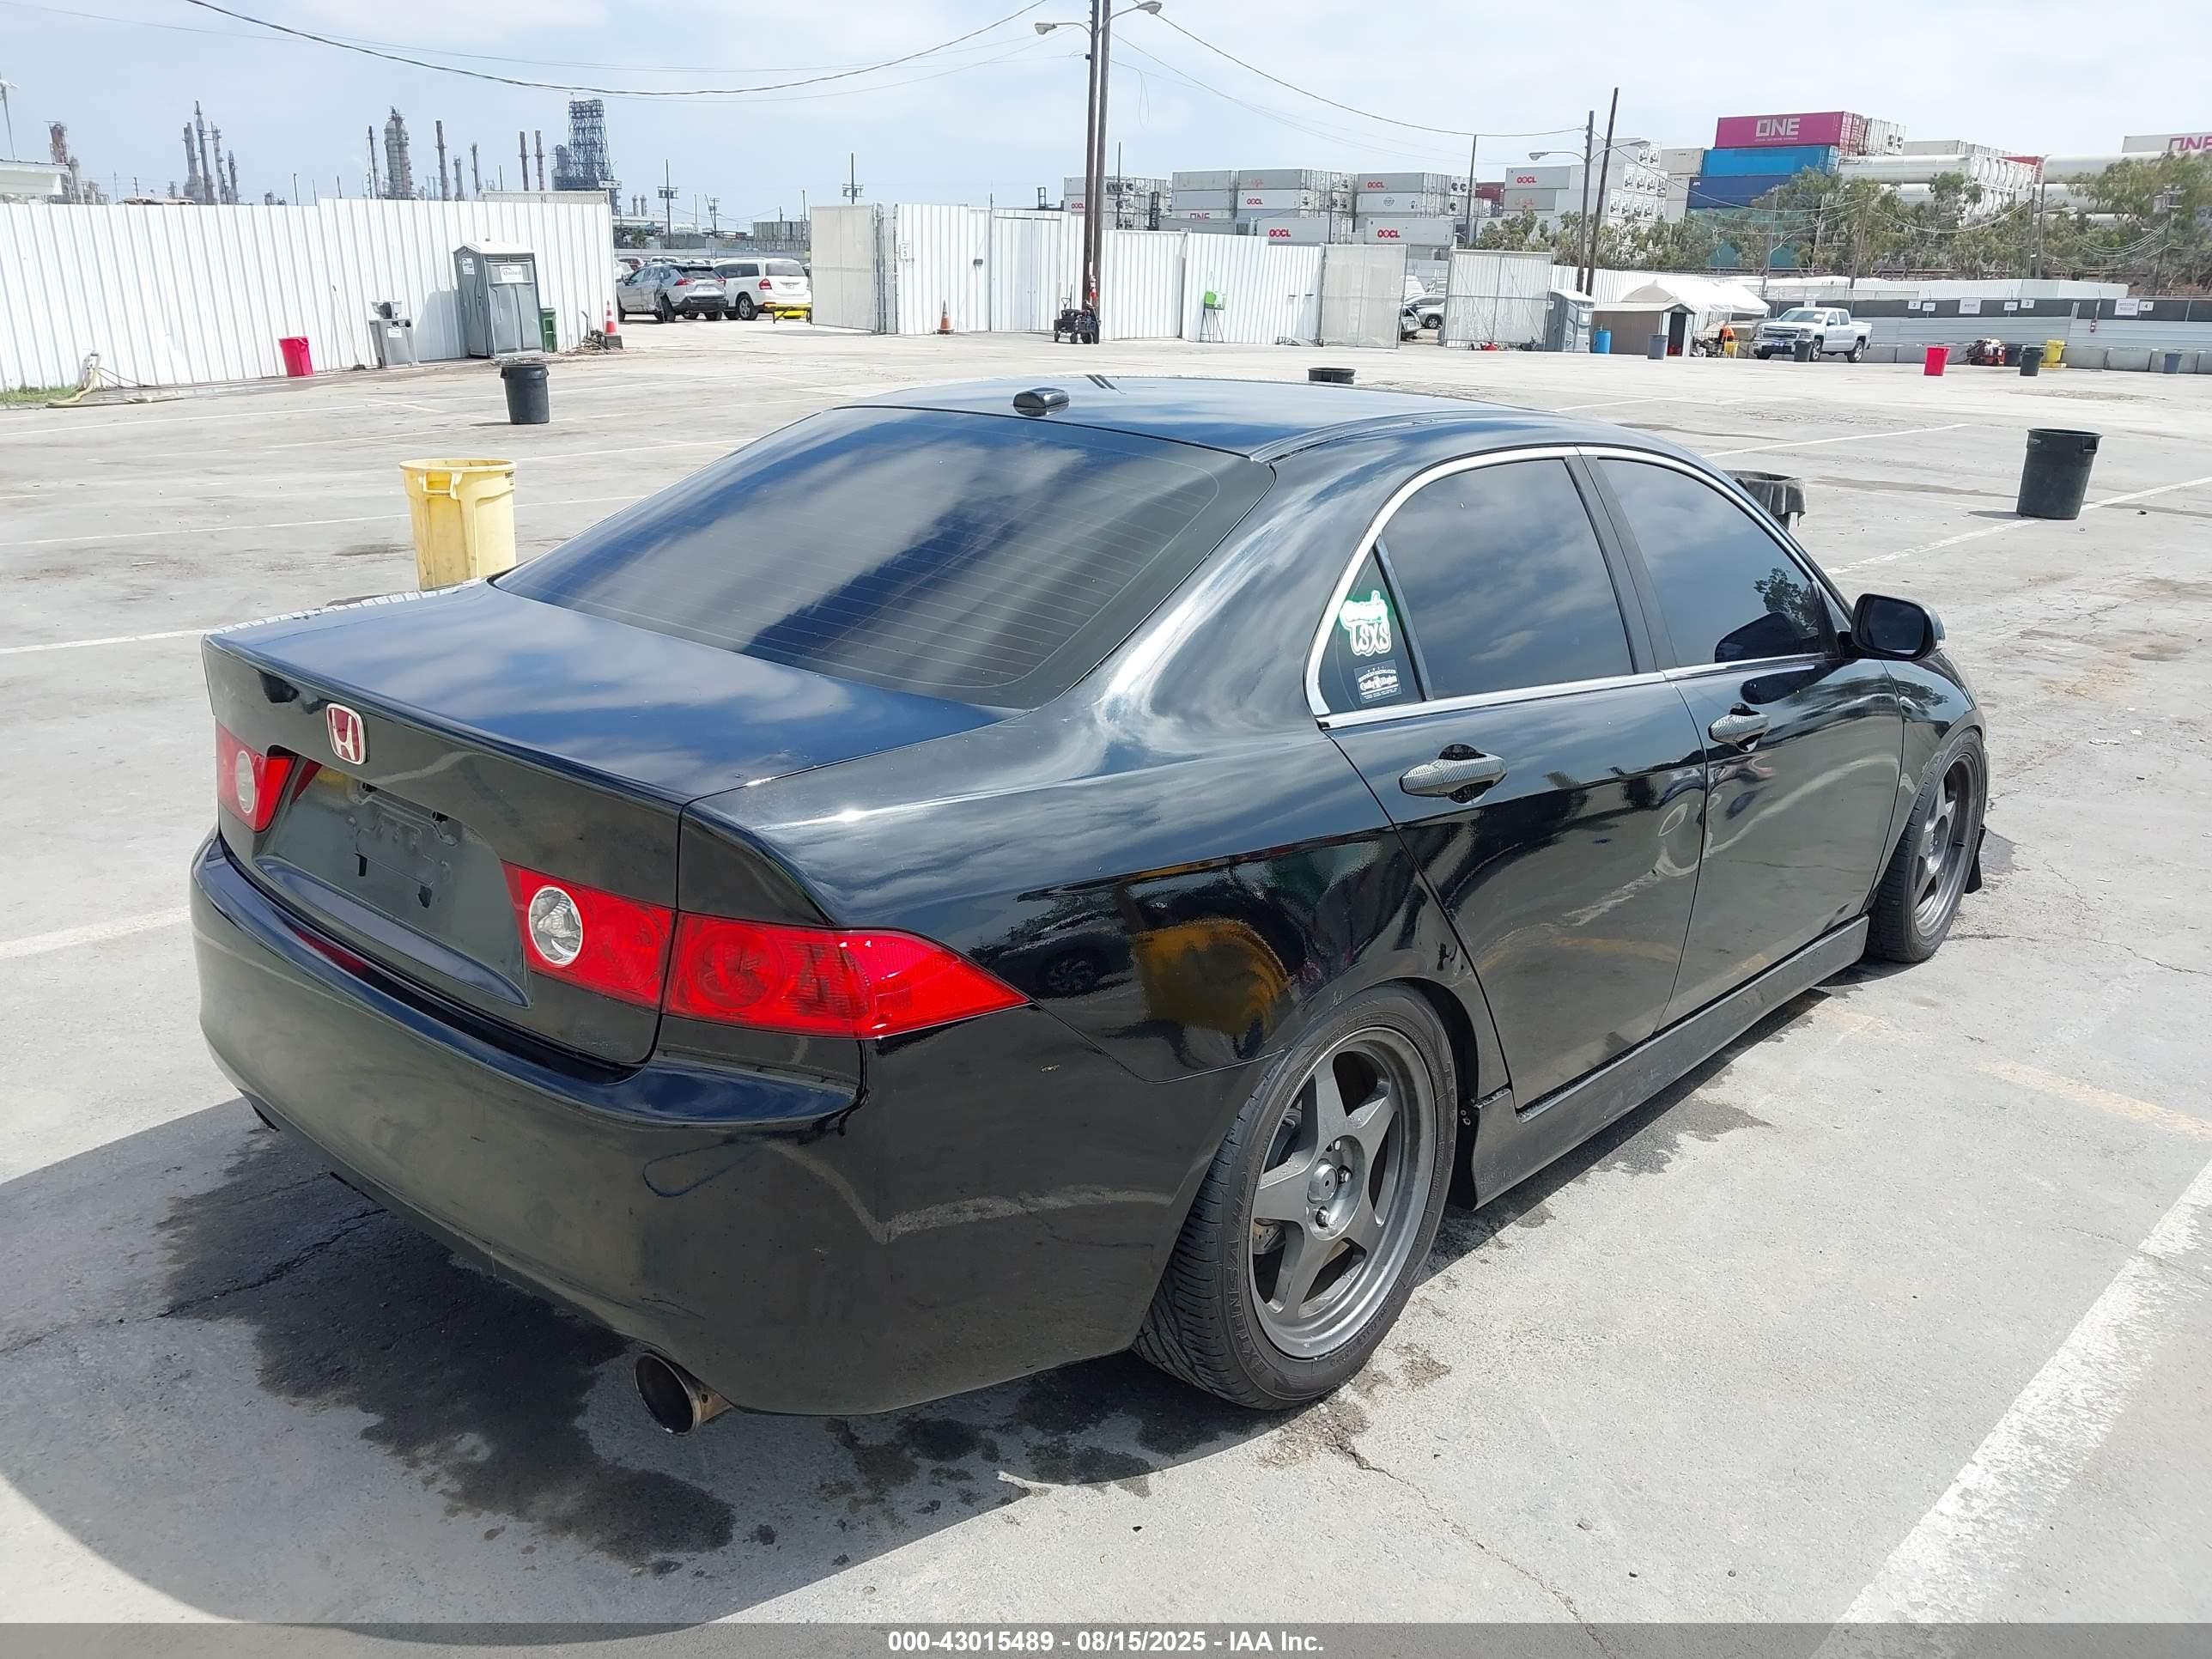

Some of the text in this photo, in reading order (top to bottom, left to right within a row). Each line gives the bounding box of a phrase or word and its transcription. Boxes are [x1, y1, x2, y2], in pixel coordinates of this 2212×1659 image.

[1755, 118, 1800, 137] ONE
[1269, 228, 1291, 237] OOCL
[1377, 229, 1401, 238] OOCL
